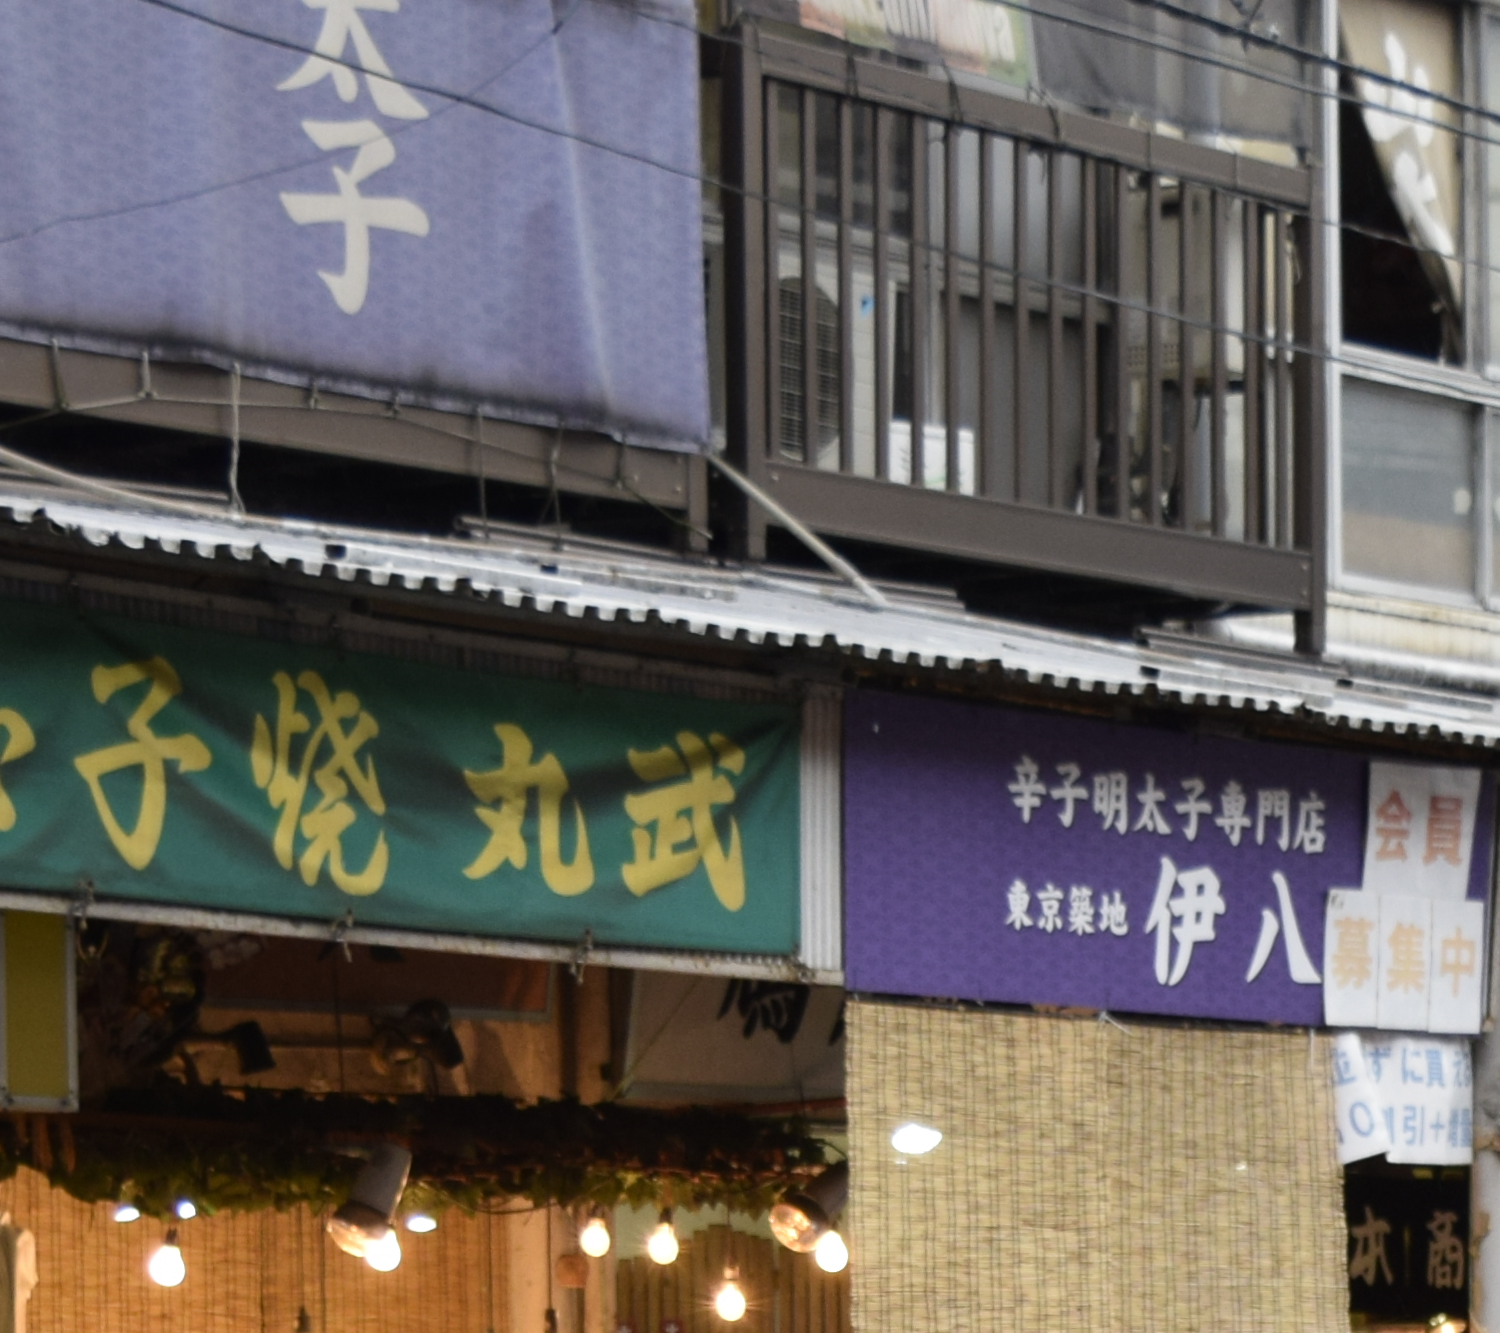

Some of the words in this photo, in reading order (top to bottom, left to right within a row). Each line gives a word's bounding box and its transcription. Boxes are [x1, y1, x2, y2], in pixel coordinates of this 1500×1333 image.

[462, 722, 749, 912] 丸武
[1006, 754, 1328, 855] 辛子明太子専門店
[1374, 788, 1465, 867] 会員
[1005, 878, 1130, 938] 東京築地
[1144, 855, 1323, 988] 伊八
[1331, 914, 1478, 998] 募集中
